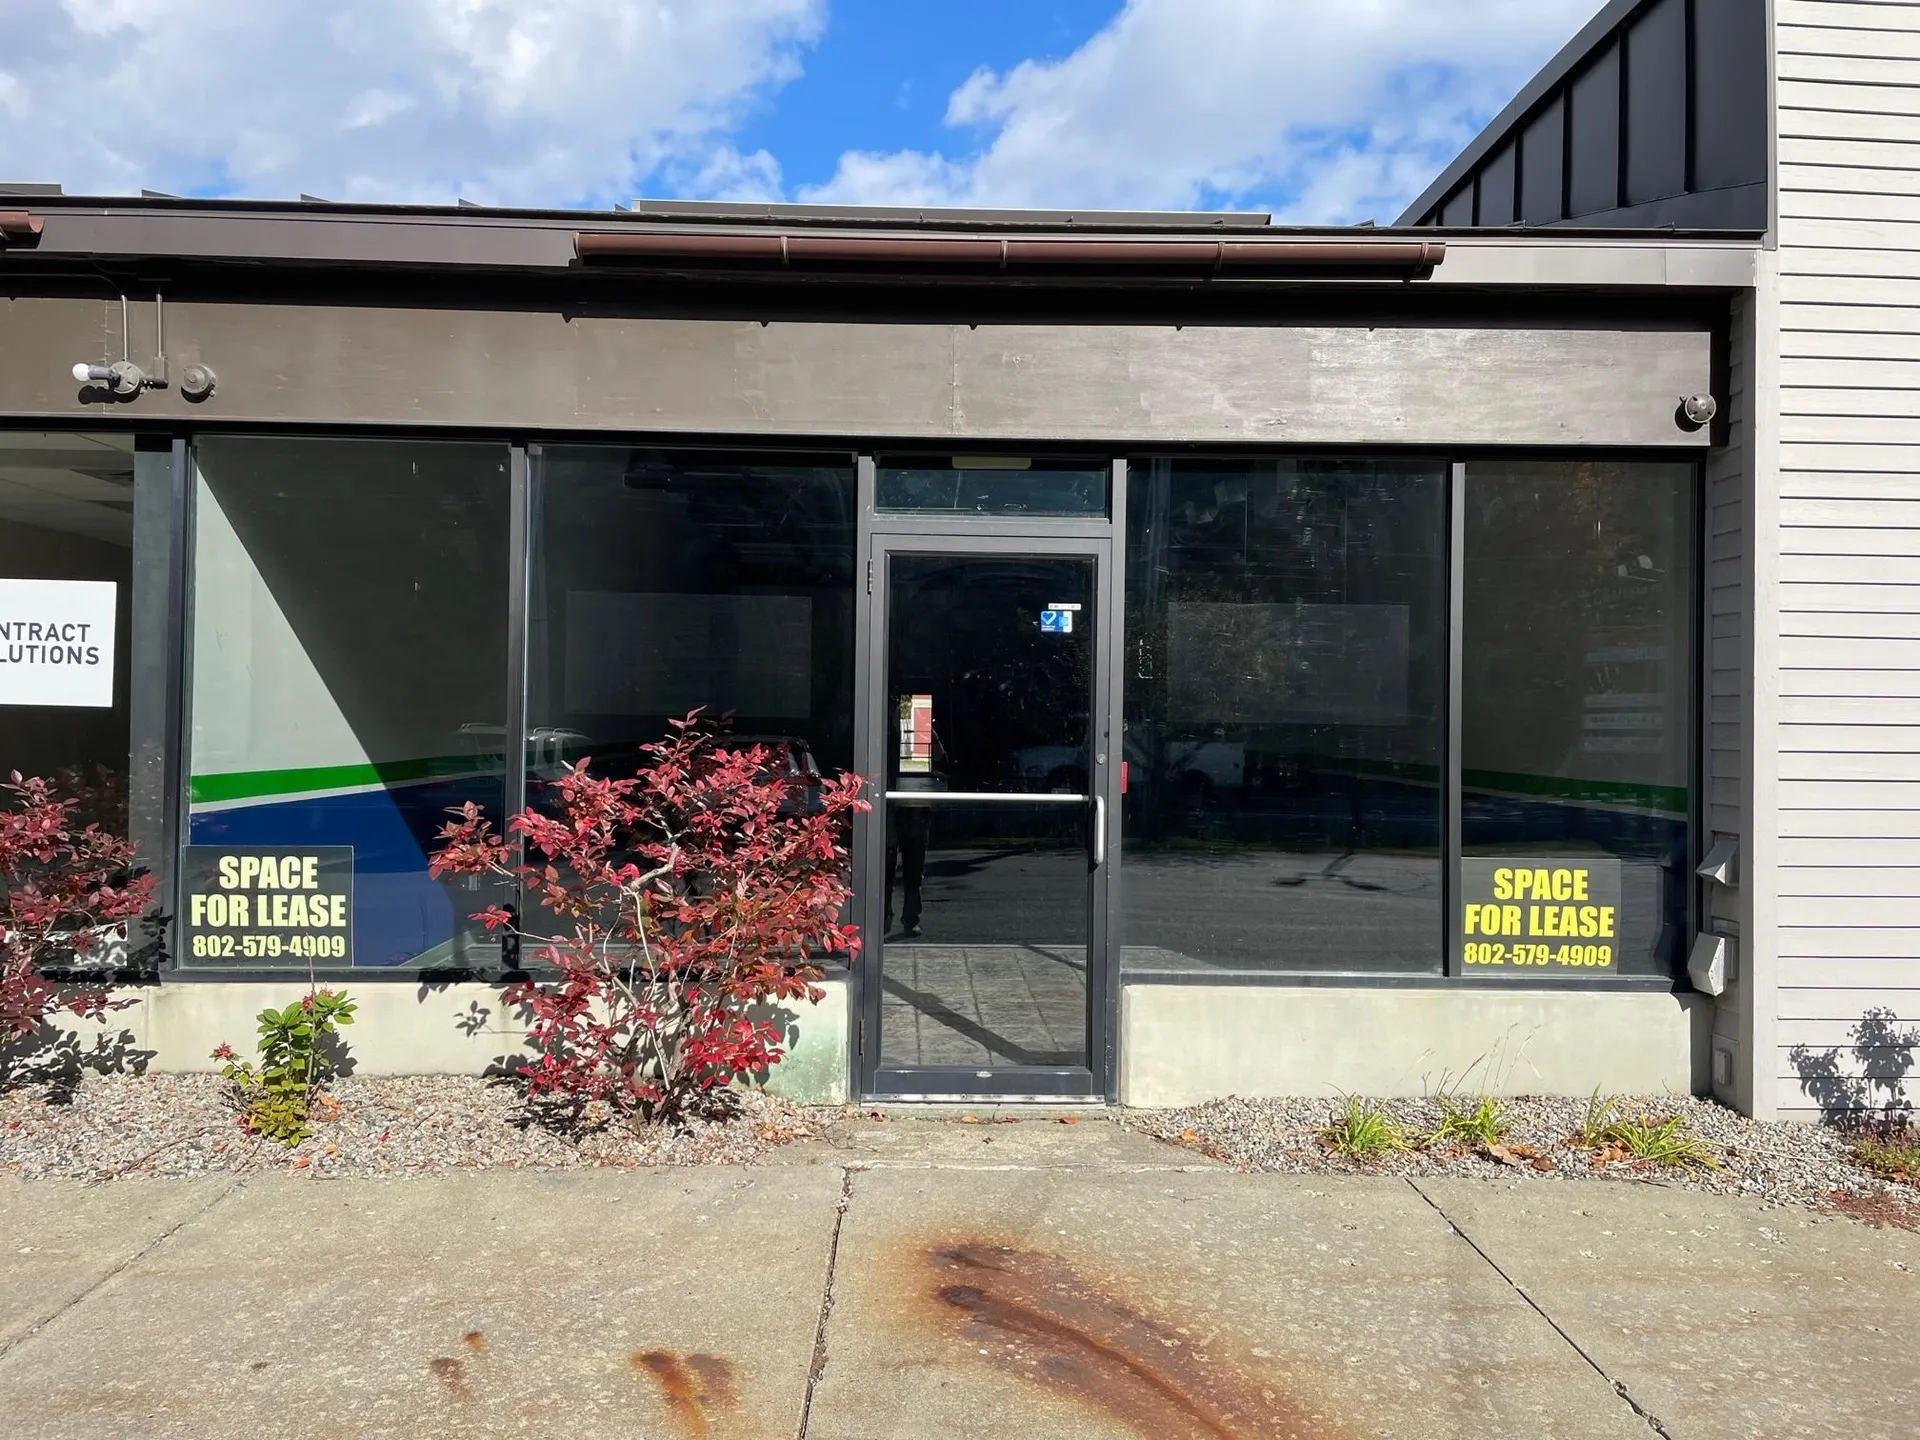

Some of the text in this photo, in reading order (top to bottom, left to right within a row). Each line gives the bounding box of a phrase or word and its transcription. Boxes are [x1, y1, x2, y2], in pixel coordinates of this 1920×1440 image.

[219, 856, 318, 889] SPACE
[1493, 868, 1588, 900] SPACE
[191, 894, 346, 927] FOR LEASE
[1464, 904, 1614, 937] FOR LEASE
[192, 935, 345, 957] 802-579-4909
[1463, 943, 1611, 966] 802-579-4909
